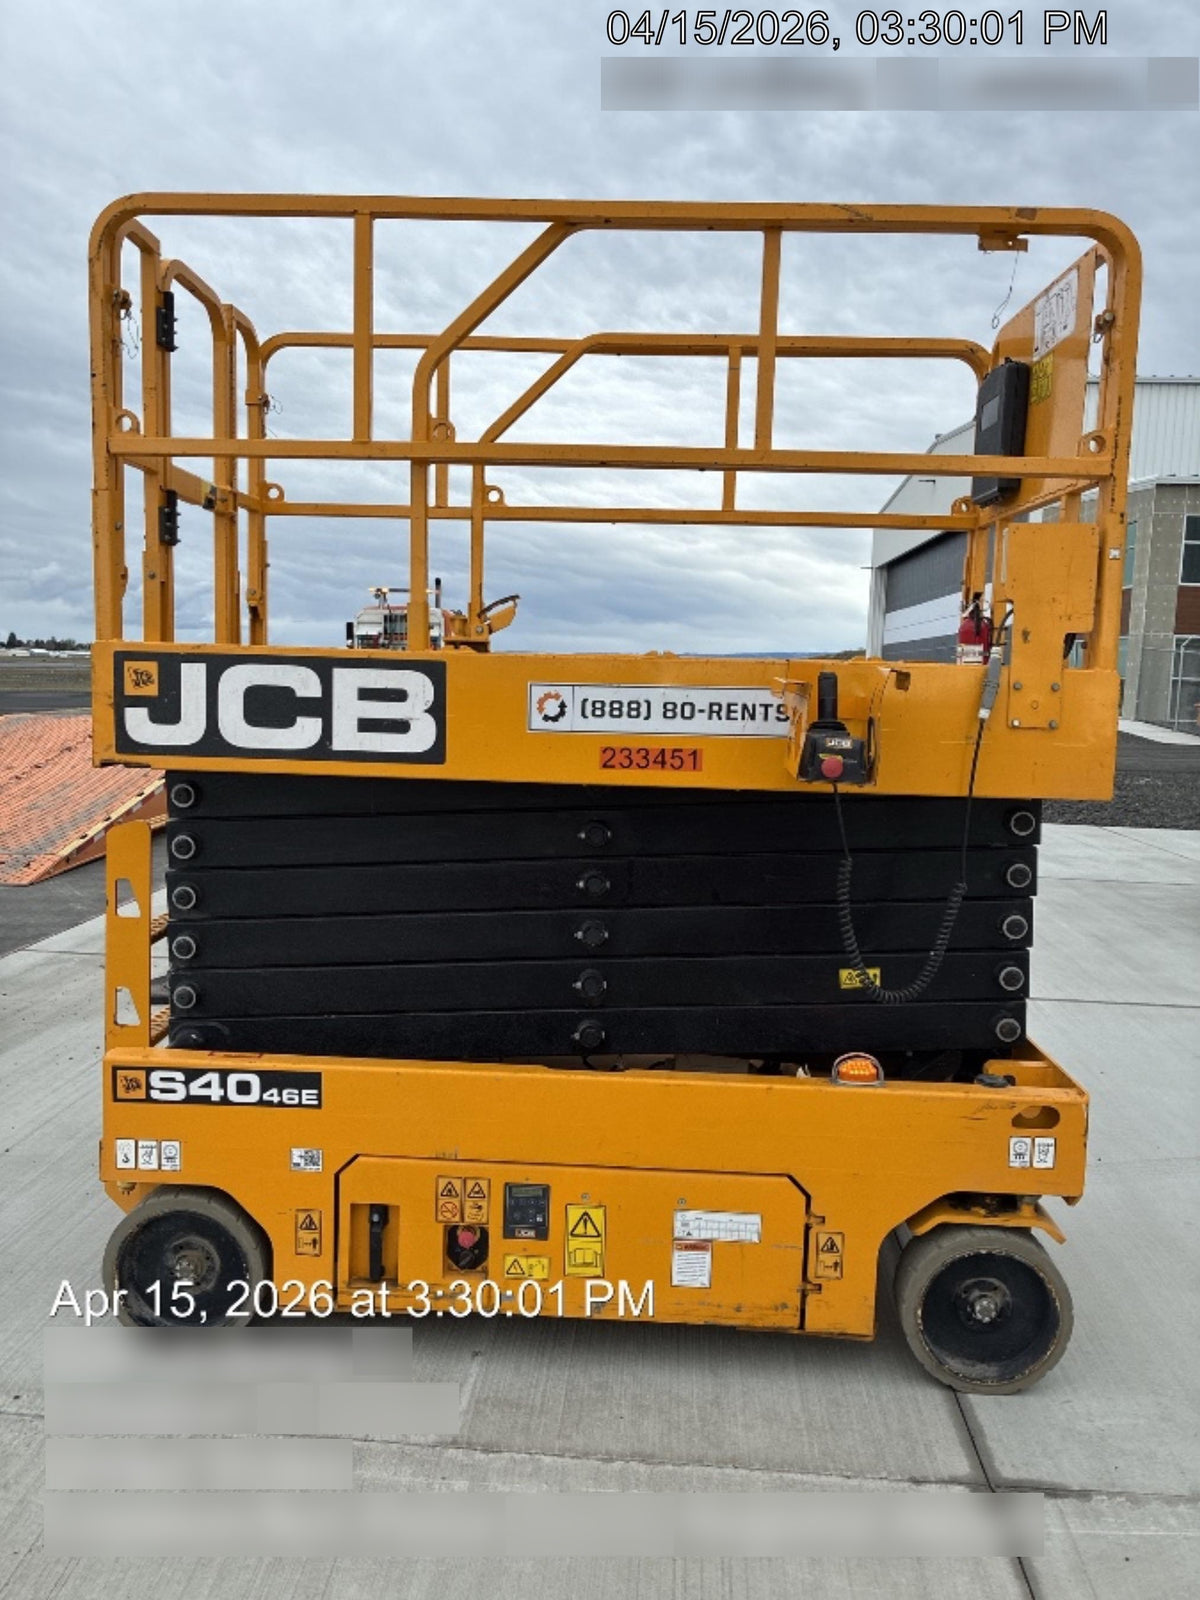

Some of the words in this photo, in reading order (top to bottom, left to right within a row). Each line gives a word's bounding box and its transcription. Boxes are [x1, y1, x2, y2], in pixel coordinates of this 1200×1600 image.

[124, 662, 437, 753] JCB
[580, 699, 652, 721] (888)
[662, 701, 790, 722] 80-RENTS
[601, 746, 698, 771] 233451
